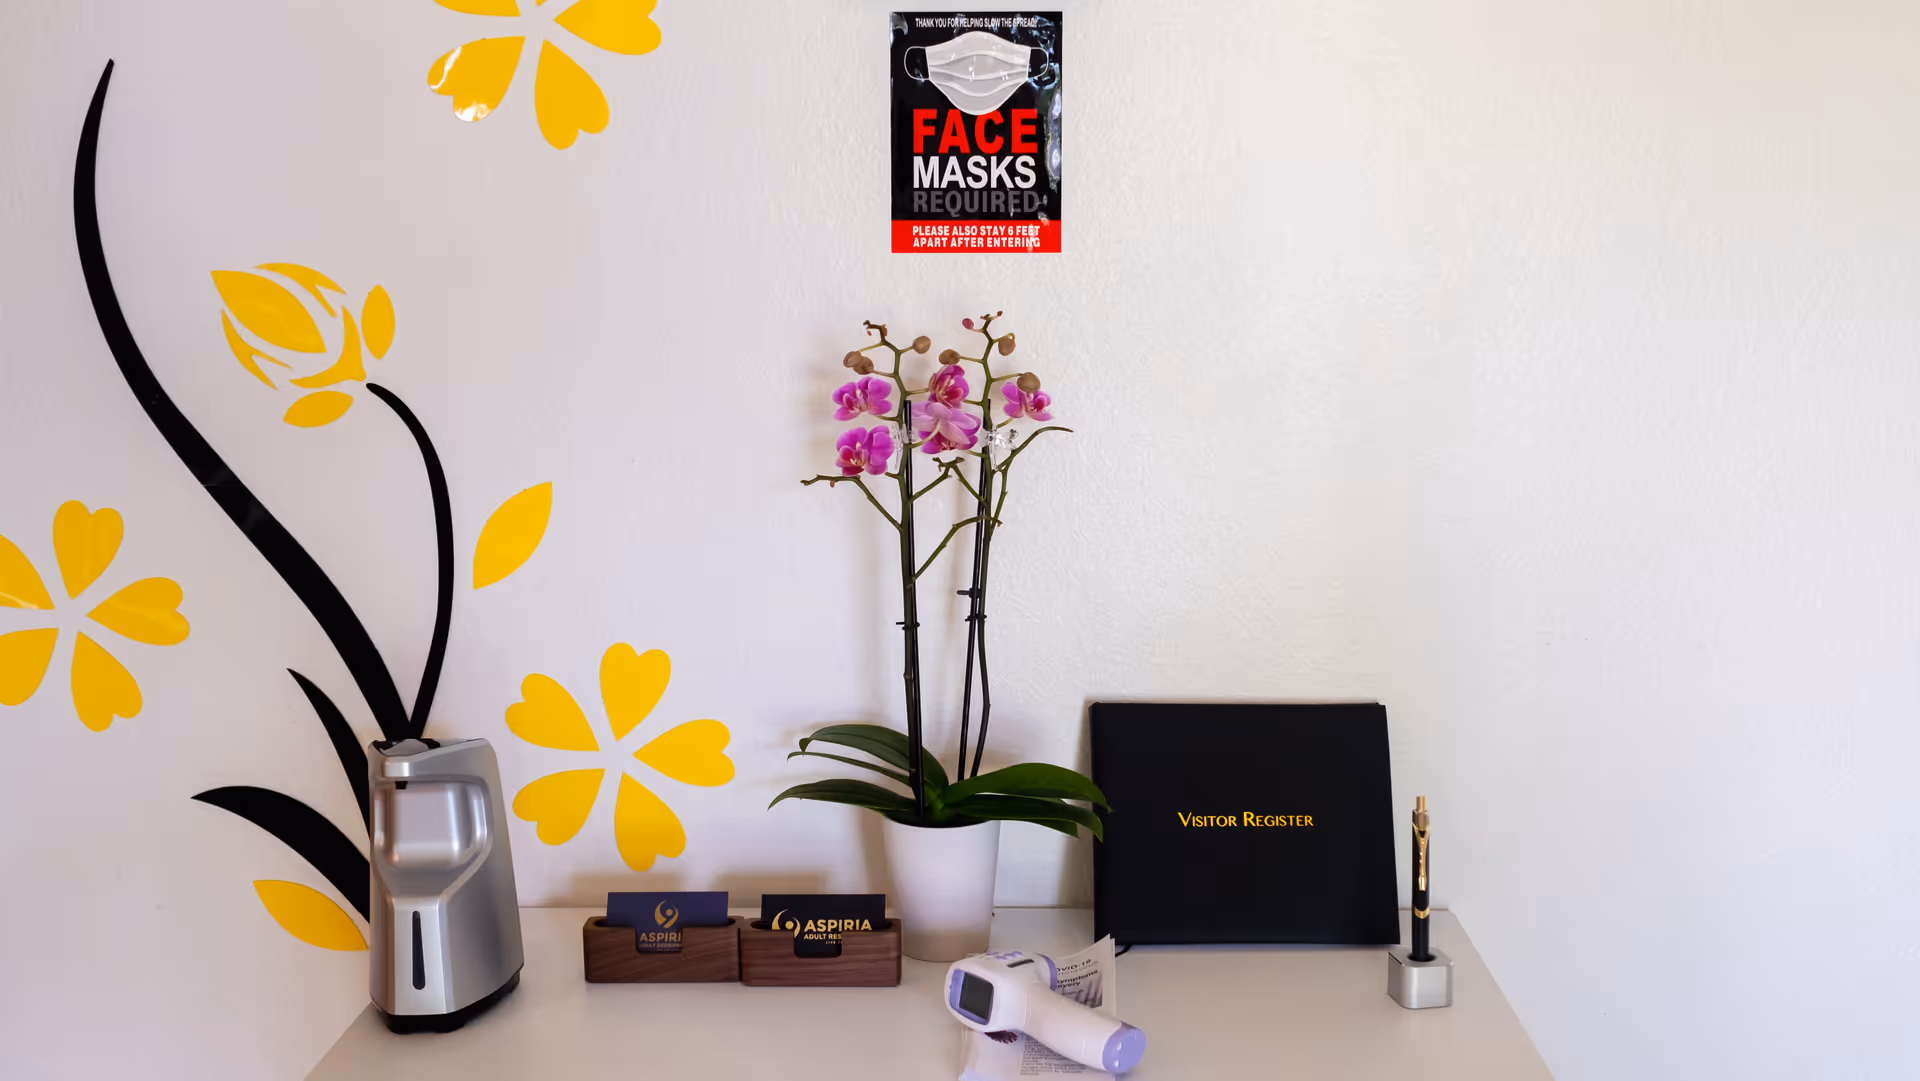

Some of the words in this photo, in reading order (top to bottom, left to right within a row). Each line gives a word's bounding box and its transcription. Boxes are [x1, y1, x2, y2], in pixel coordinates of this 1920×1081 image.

[915, 17, 935, 27] THANK
[935, 17, 947, 27] YOU
[947, 17, 959, 27] FOR
[959, 17, 983, 28] HELPING
[984, 17, 1000, 28] SLOW
[1001, 17, 1012, 27] THE
[912, 108, 1038, 154] FACE
[913, 155, 1037, 189] MASKS
[913, 190, 1040, 217] REQUIRED
[912, 225, 950, 236] PLEASE
[952, 225, 978, 236] ALSO
[980, 225, 1006, 236] STAY
[1007, 225, 1014, 236] 6
[1016, 225, 1041, 236] FEET
[913, 237, 948, 248] APART
[950, 237, 984, 248] AFTER
[986, 237, 1041, 248] ENTERING
[804, 919, 873, 932] ASPIRIA
[640, 932, 681, 942] ASPIRI
[1057, 959, 1091, 972] OVID-19
